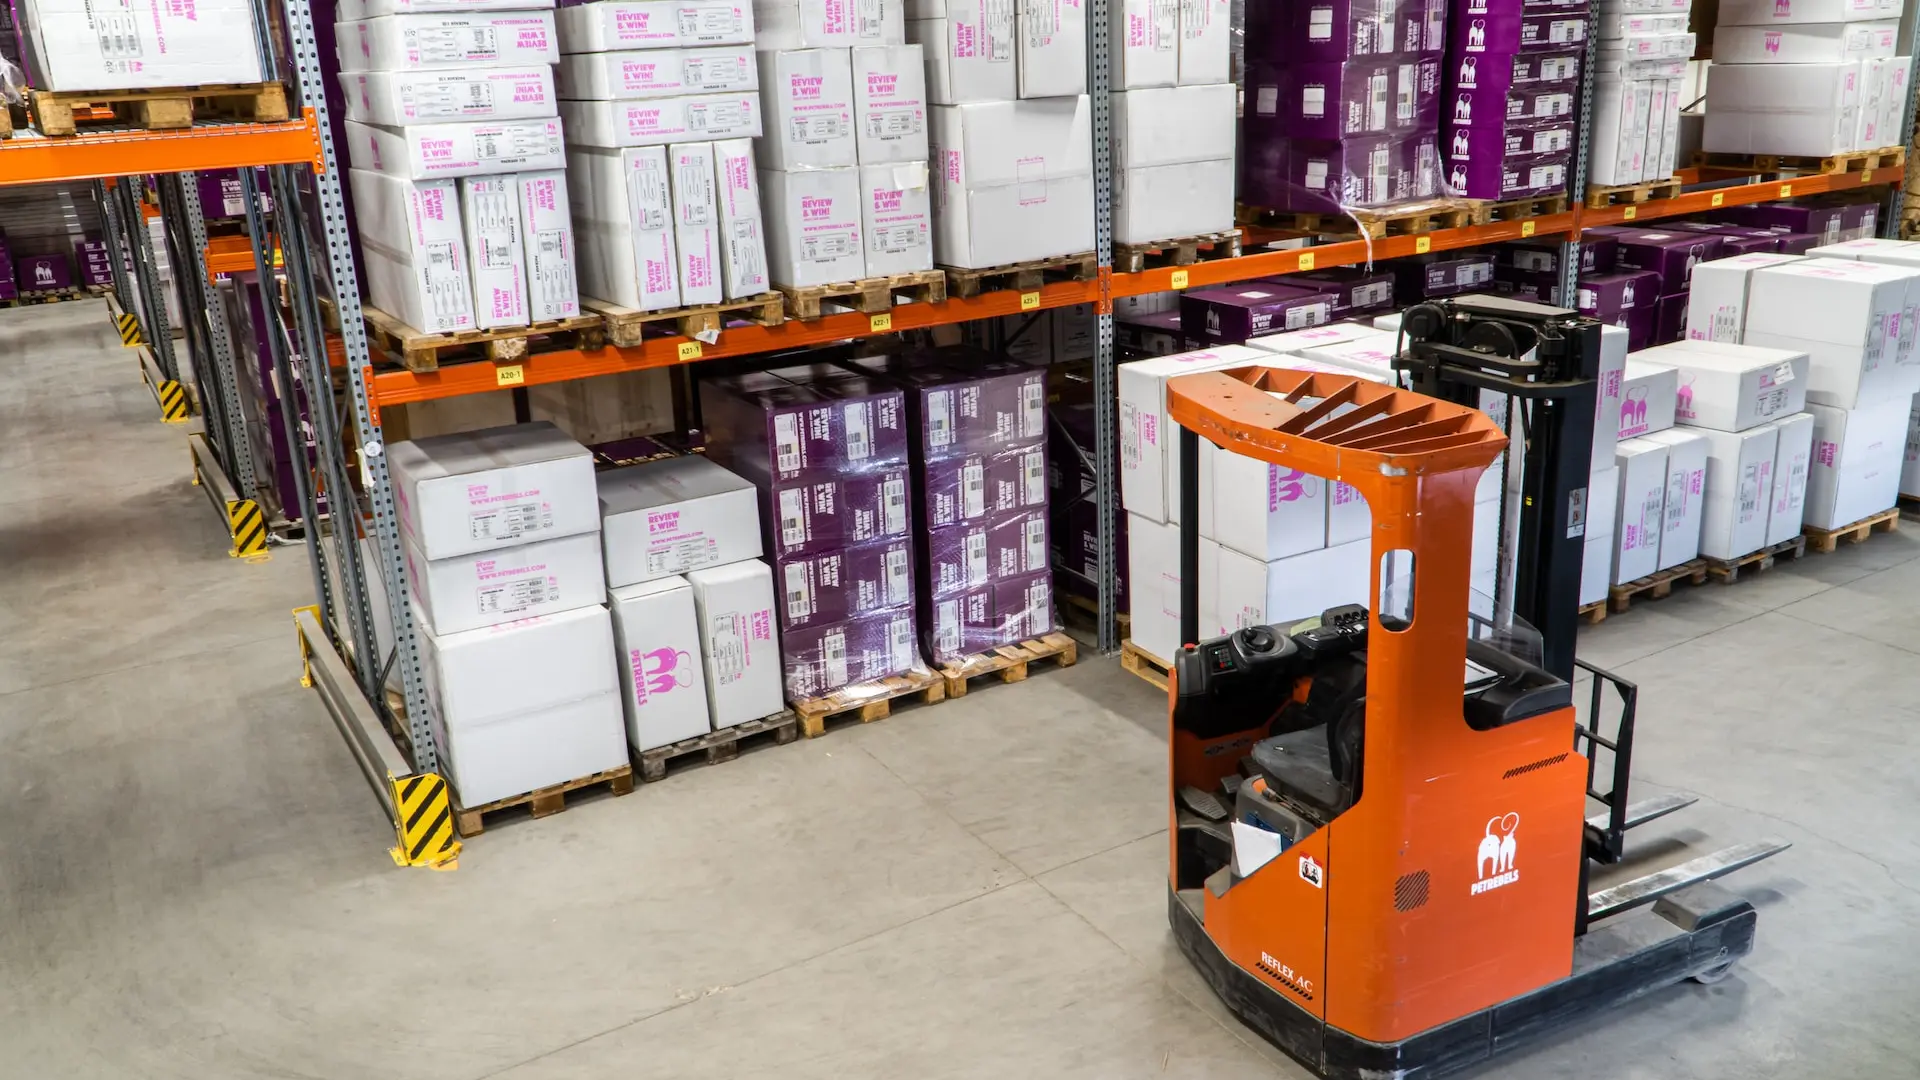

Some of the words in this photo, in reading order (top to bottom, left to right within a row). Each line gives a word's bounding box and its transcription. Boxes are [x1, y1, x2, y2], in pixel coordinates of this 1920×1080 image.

[616, 12, 650, 22] REVIEW
[626, 22, 647, 30] WIN!
[517, 38, 547, 48] REVIEW
[518, 31, 536, 40] WIN!
[956, 22, 965, 58] REVIEW
[623, 64, 656, 72] REVIEW
[632, 72, 654, 80] WIN!
[792, 77, 823, 87] REVIEW
[868, 75, 898, 84] REVIEW
[515, 86, 532, 94] WIN!
[801, 87, 820, 96] WIN!
[877, 84, 895, 92] WIN!
[514, 94, 544, 103] REVIEW
[628, 109, 660, 118] REVIEW
[637, 118, 658, 126] WIN!
[421, 140, 453, 151] REVIEW
[430, 149, 452, 158] WIN!
[538, 188, 546, 208] WIN!
[545, 180, 556, 211] REVIEW
[874, 190, 903, 200] REVIEW
[425, 197, 434, 220] WIN!
[432, 189, 444, 221] REVIEW
[802, 199, 832, 208] REVIEW
[882, 200, 900, 208] WIN!
[811, 208, 830, 217] WIN!
[647, 260, 656, 293] REVIEW
[655, 262, 663, 284] WIN!
[494, 288, 502, 318] REVIEW
[682, 346, 700, 356] A21-1
[501, 370, 521, 380] A20-1
[970, 386, 978, 418] REVIEW
[888, 398, 897, 430] REVIEW
[814, 420, 822, 440] WIN!
[820, 408, 830, 442] REVIEW
[1270, 463, 1278, 513] ETREBELS
[818, 494, 826, 514] WIN!
[825, 483, 834, 514] REVIEW
[648, 511, 680, 524] REVIEW
[658, 520, 678, 530] WIN!
[855, 509, 864, 542] REVIEW
[823, 566, 832, 586] WIN!
[830, 556, 840, 588] REVIEW
[866, 581, 874, 601] WIN!
[755, 619, 763, 640] WIN!
[762, 610, 770, 640] REVIEW
[630, 650, 648, 706] PETREBELS
[1470, 869, 1519, 896] PETREBELS
[1261, 952, 1294, 981] REFLEX
[1296, 976, 1313, 992] AC
